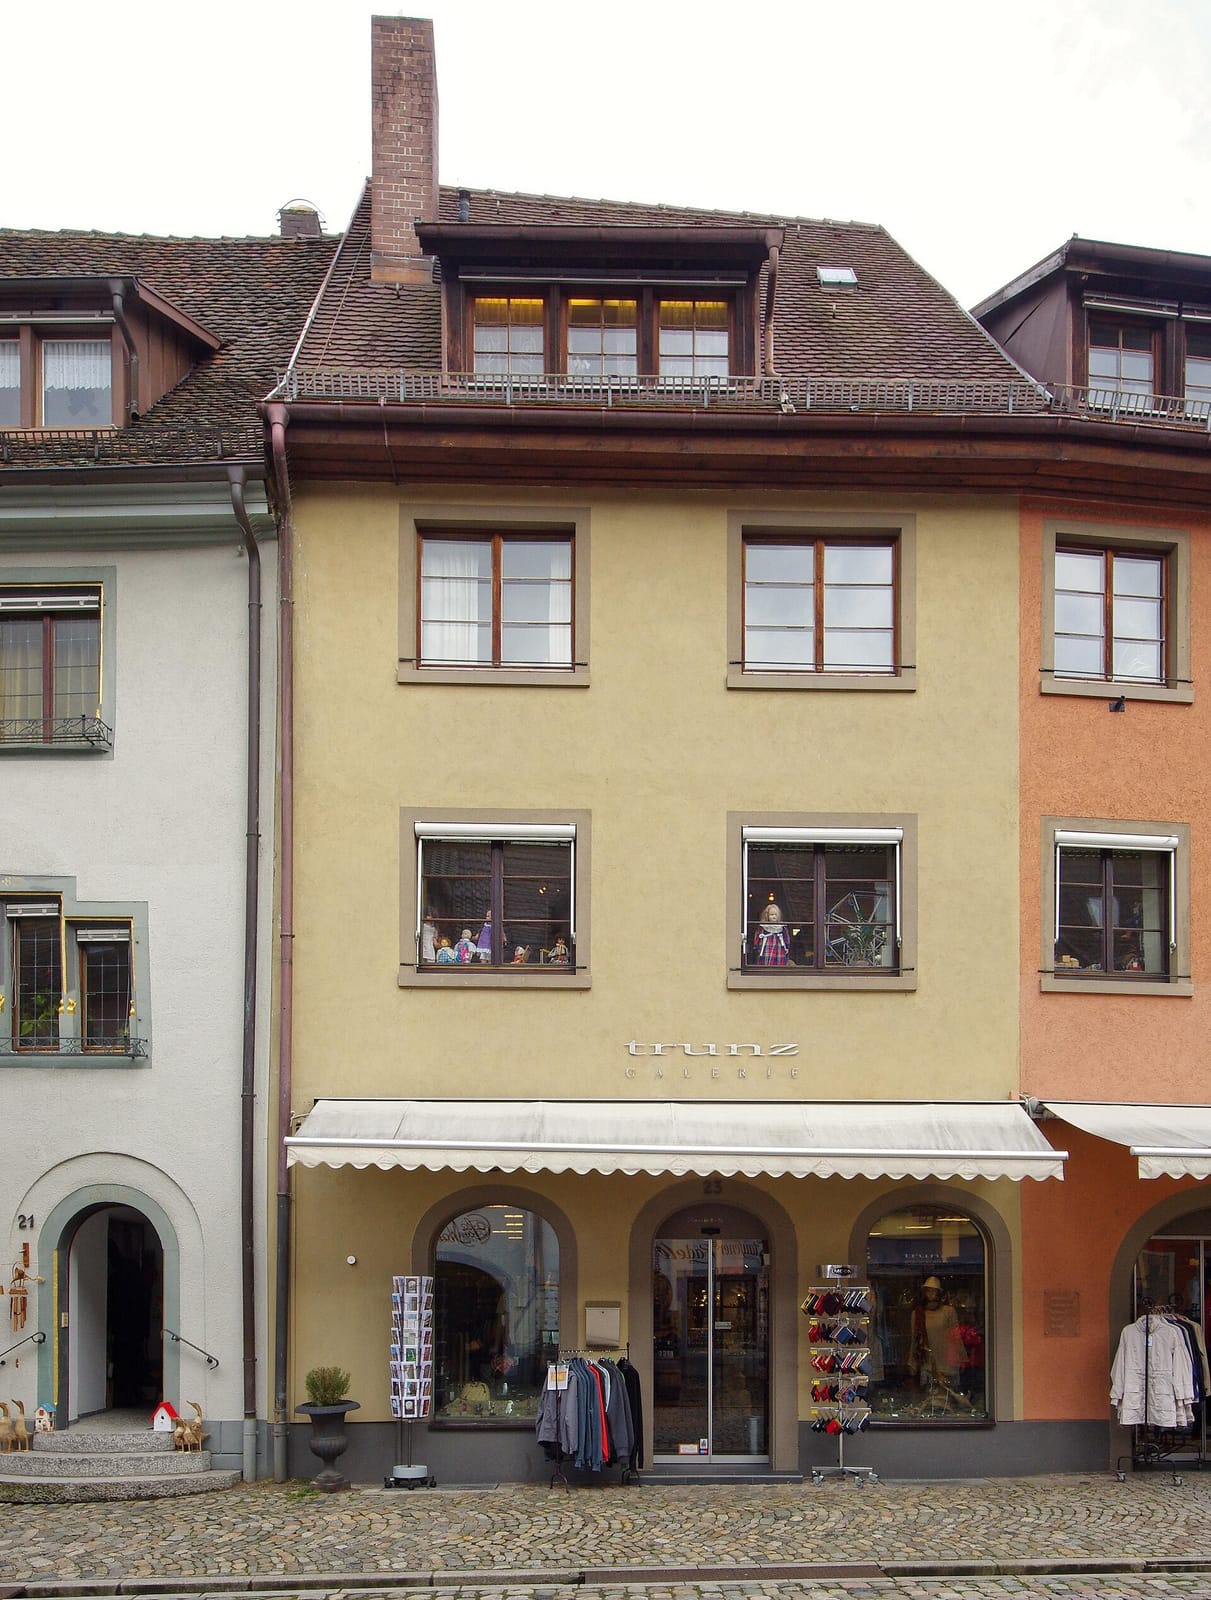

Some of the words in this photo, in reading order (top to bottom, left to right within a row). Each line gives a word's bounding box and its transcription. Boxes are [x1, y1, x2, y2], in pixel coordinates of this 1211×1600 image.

[625, 1040, 799, 1056] trunz
[625, 1068, 799, 1080] GALERIE
[18, 1214, 34, 1230] 21
